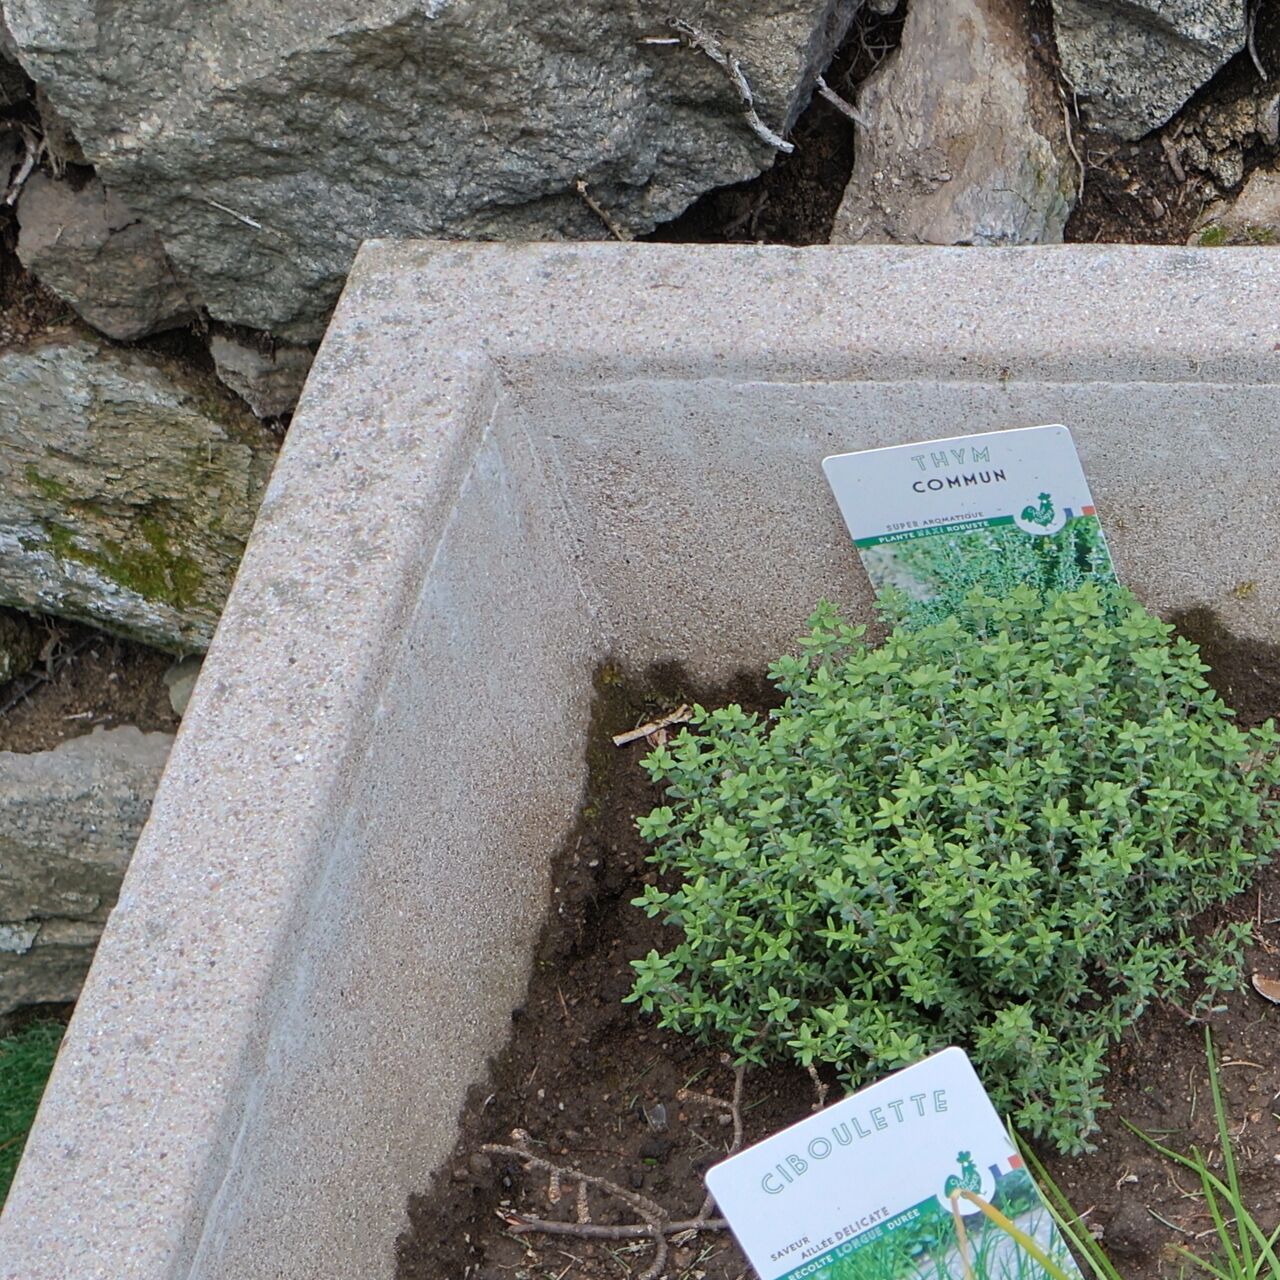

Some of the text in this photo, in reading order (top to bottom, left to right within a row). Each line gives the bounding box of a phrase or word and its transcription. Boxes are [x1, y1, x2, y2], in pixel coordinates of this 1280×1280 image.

[911, 446, 991, 472] THYM
[912, 469, 1007, 494] COMMUN
[879, 532, 916, 544] PLANTE
[946, 520, 990, 533] ROBUSTE
[886, 511, 984, 532] SUPER AROMATIQUE
[761, 1090, 948, 1195] CIBOULETTE
[770, 1236, 811, 1262] SAVEUR
[835, 1226, 884, 1258] LONGUE
